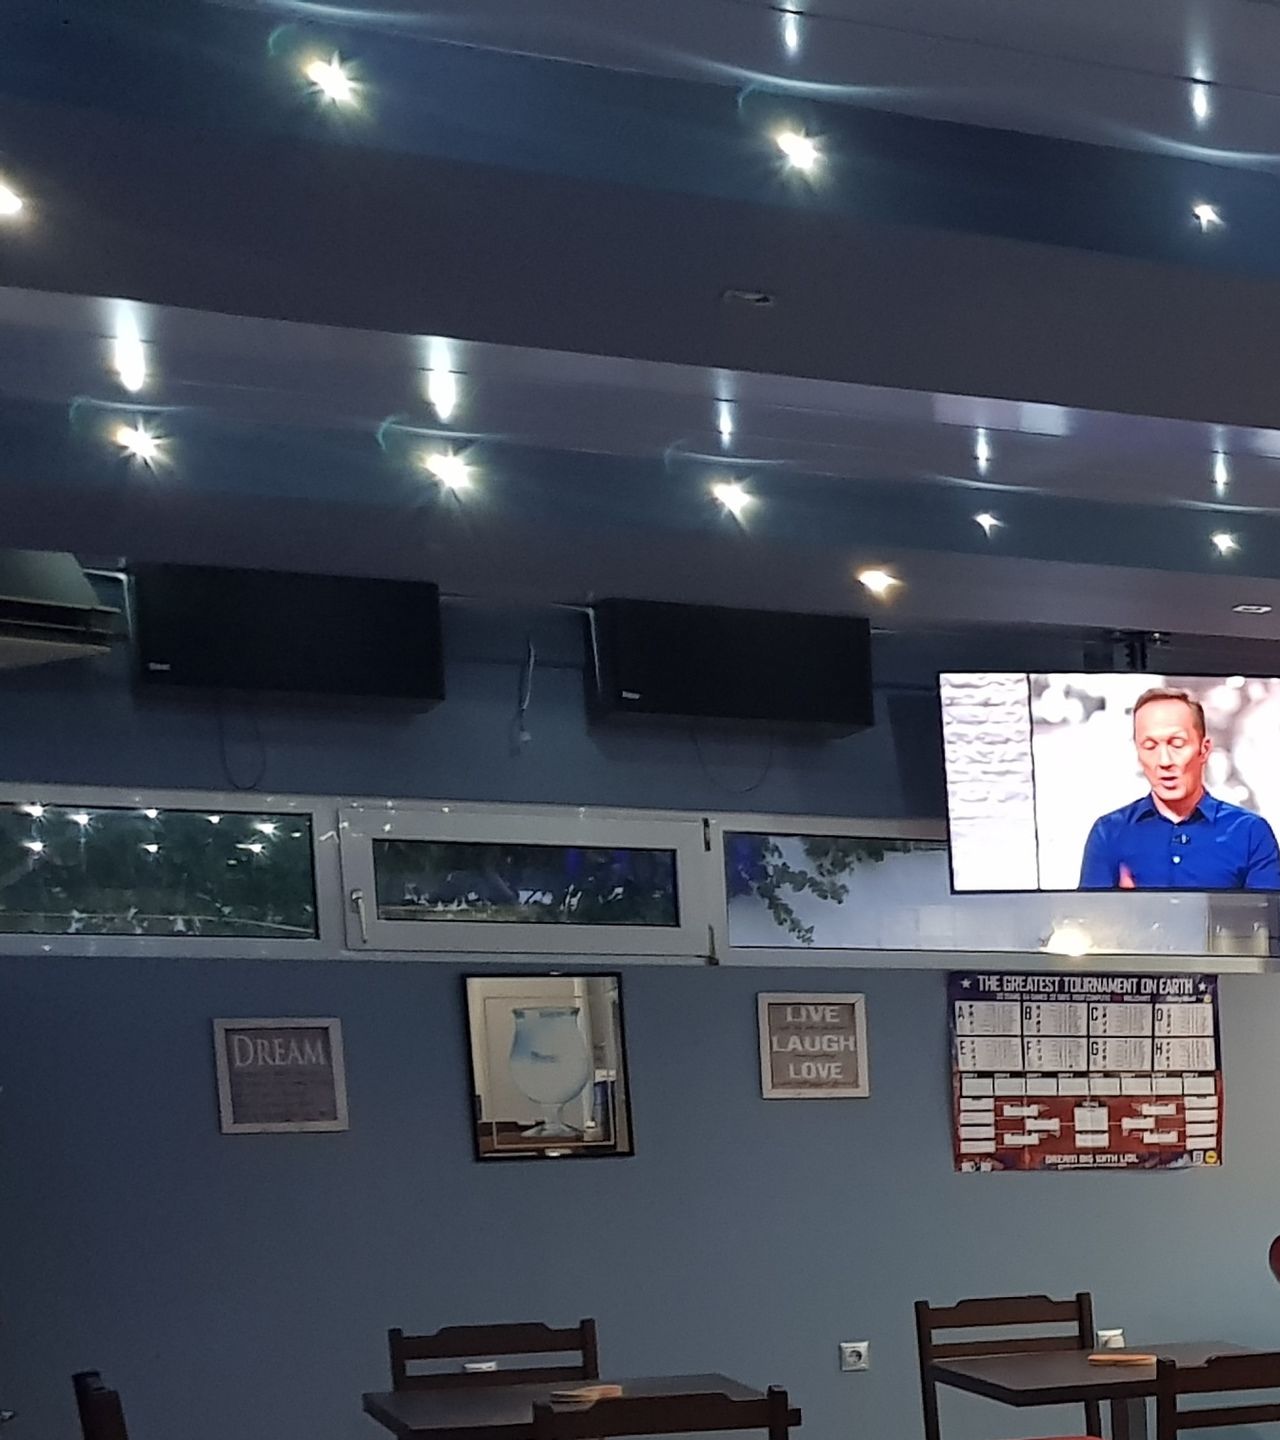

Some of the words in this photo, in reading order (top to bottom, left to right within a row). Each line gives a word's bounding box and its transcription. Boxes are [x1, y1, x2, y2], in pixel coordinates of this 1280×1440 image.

[977, 975, 1001, 992] THE
[1003, 976, 1061, 993] GREATEST
[1063, 977, 1139, 994] TOURNAMENT
[1141, 979, 1158, 994] ON
[1160, 979, 1193, 996] EARTH
[786, 1006, 840, 1022] LIVE
[958, 1005, 965, 1020] A
[1024, 1005, 1032, 1020] B
[1091, 1007, 1099, 1021] C
[231, 1035, 325, 1067] DREAM
[772, 1035, 856, 1052] LAUGH
[960, 1040, 967, 1055] E
[1091, 1041, 1099, 1056] G
[1155, 1042, 1163, 1057] H
[788, 1062, 843, 1079] LOVE
